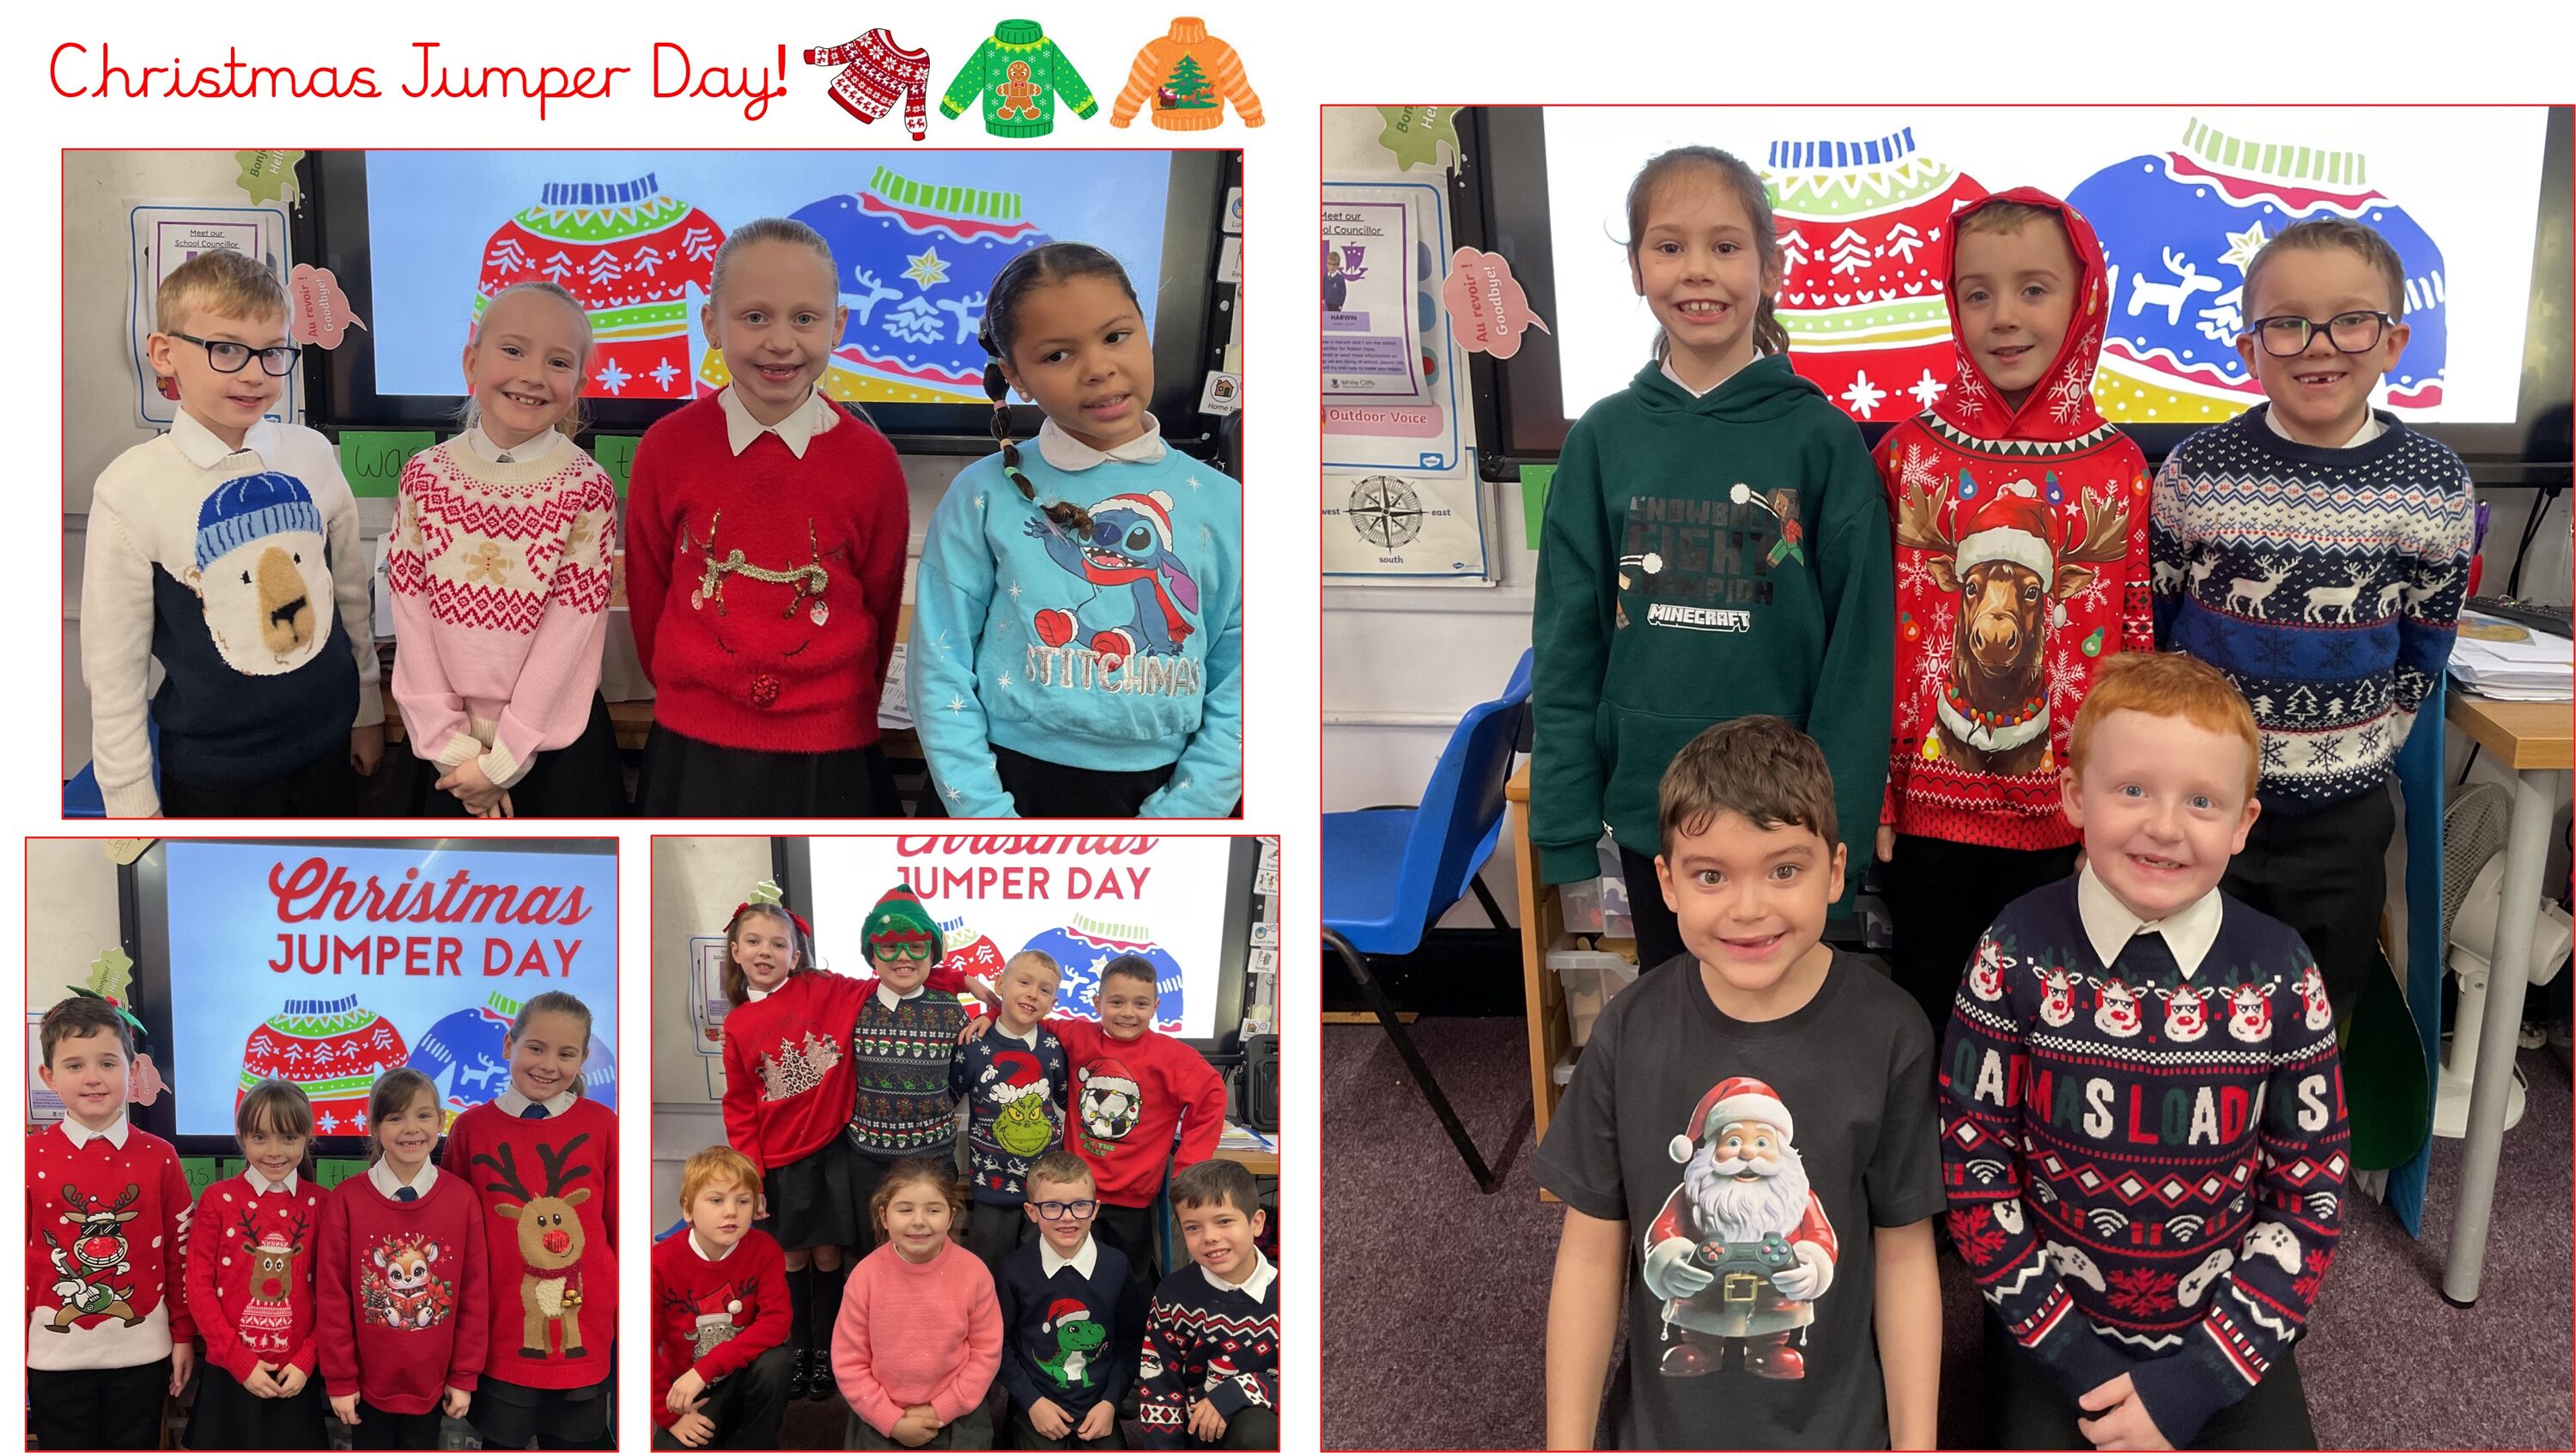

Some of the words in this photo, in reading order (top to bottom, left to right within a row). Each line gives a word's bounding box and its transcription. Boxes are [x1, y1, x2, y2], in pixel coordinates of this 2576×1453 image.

[174, 240, 200, 248] School
[201, 240, 239, 249] Councillor
[1334, 226, 1381, 235] Councillor
[299, 284, 315, 319] revoir
[316, 277, 334, 332] Goodbye!
[1463, 274, 1484, 318] revoir
[1483, 266, 1509, 336] Goodbye!
[308, 321, 319, 337] Au
[1476, 322, 1489, 343] Au
[1207, 403, 1229, 411] Home
[1329, 409, 1386, 422] Outdoor
[1390, 411, 1427, 423] Voice
[1379, 555, 1404, 563] south
[1647, 604, 1750, 631] MINECRAFT
[1024, 643, 1200, 698] STITCHMAS
[268, 856, 592, 926] Christmas
[897, 866, 1049, 899] JUMPER
[1068, 866, 1151, 899] DAY
[268, 933, 462, 977] JUMPER
[483, 938, 583, 978] DAY
[95, 964, 111, 994] Bonjour
[1939, 1037, 2029, 1109] OAD
